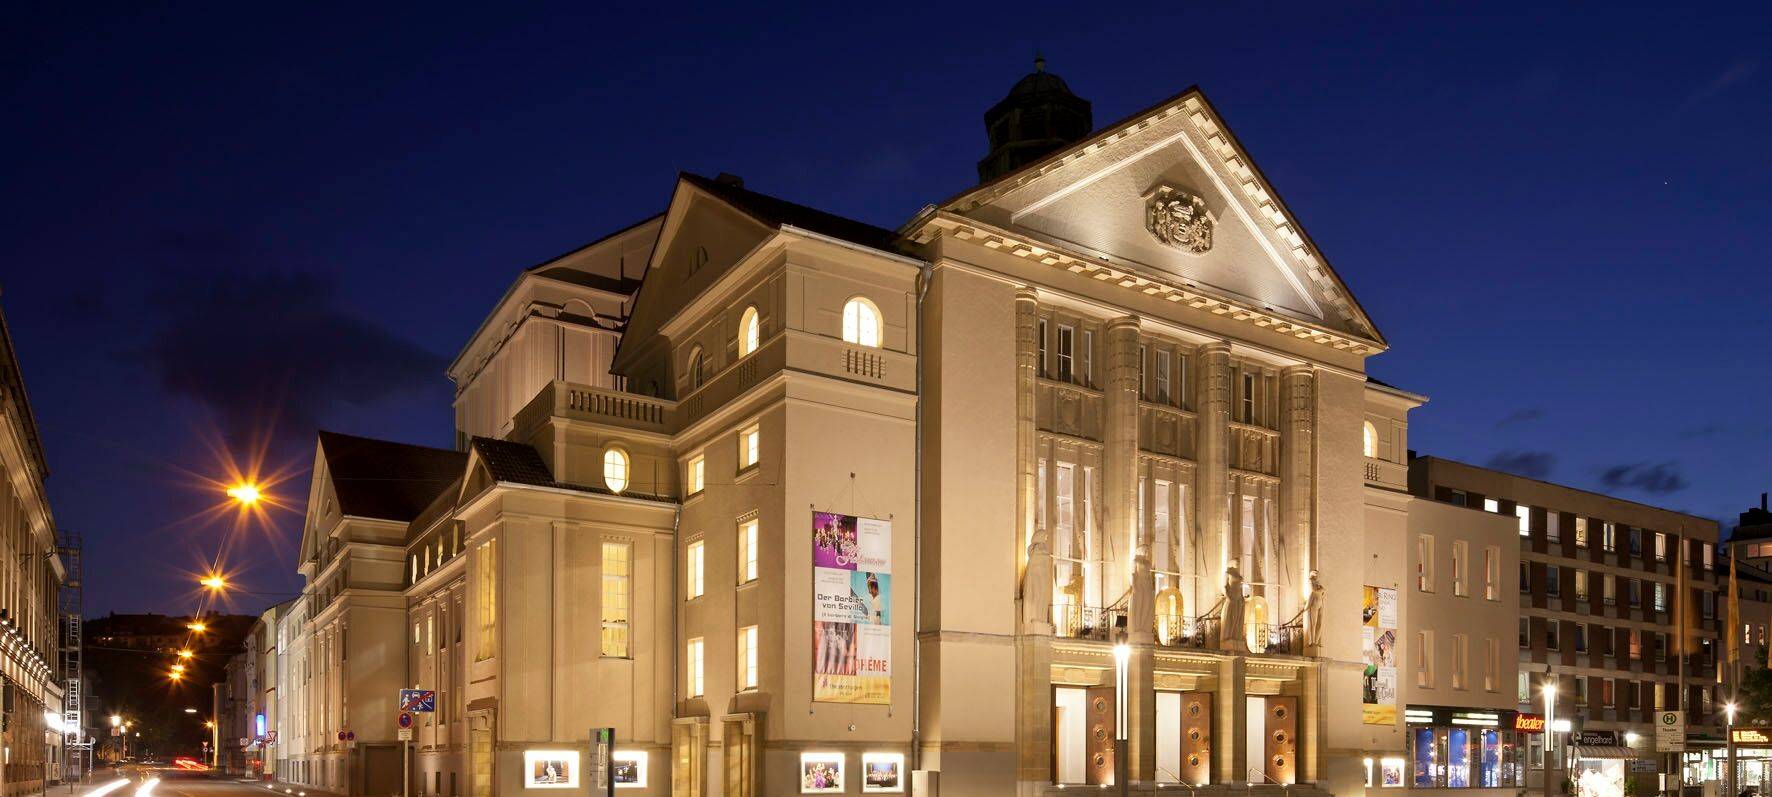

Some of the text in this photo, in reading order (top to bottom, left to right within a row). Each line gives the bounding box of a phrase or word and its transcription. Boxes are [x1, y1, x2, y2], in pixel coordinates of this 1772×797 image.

[834, 594, 864, 603] Barbier
[838, 603, 863, 611] Sevilla
[1516, 714, 1544, 730] theater
[1583, 736, 1613, 746] engelhard
